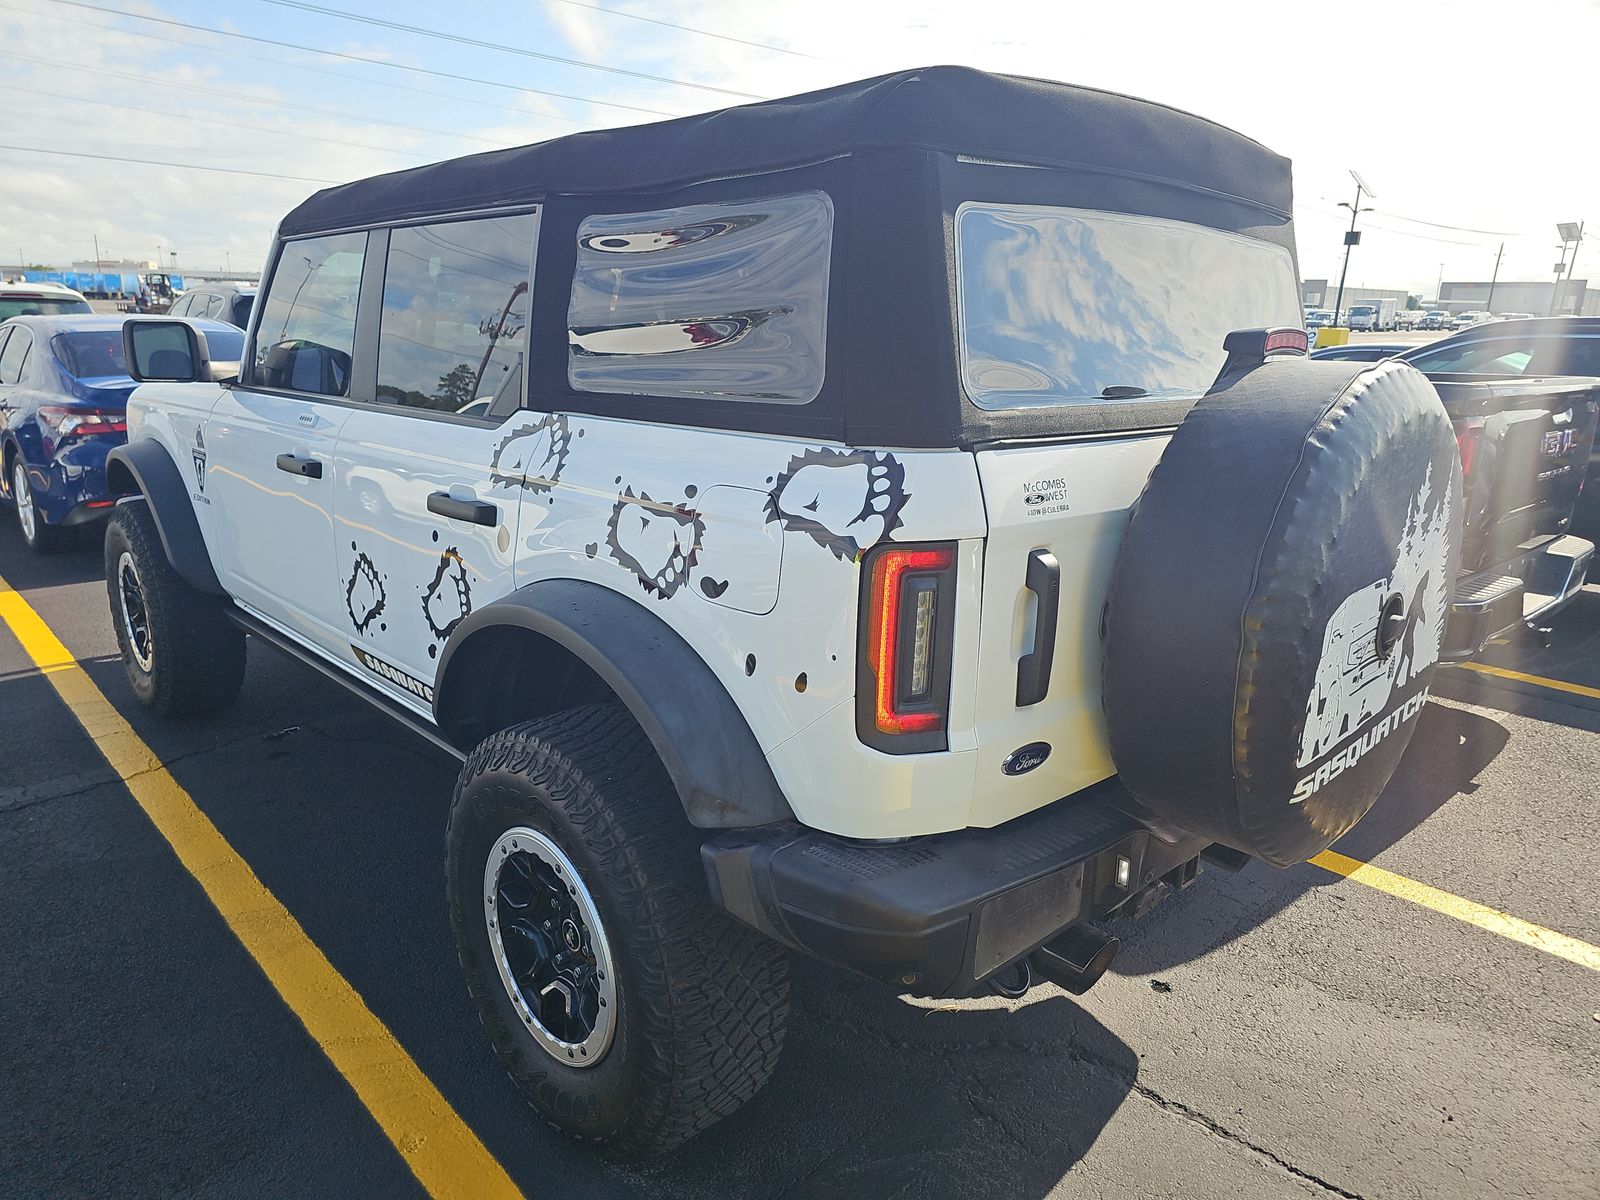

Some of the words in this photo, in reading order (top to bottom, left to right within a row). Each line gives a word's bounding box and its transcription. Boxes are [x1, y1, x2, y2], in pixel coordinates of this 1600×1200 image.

[1044, 489, 1068, 502] WEST
[1289, 685, 1430, 804] SASQUATCH
[1015, 751, 1043, 771] Ford
